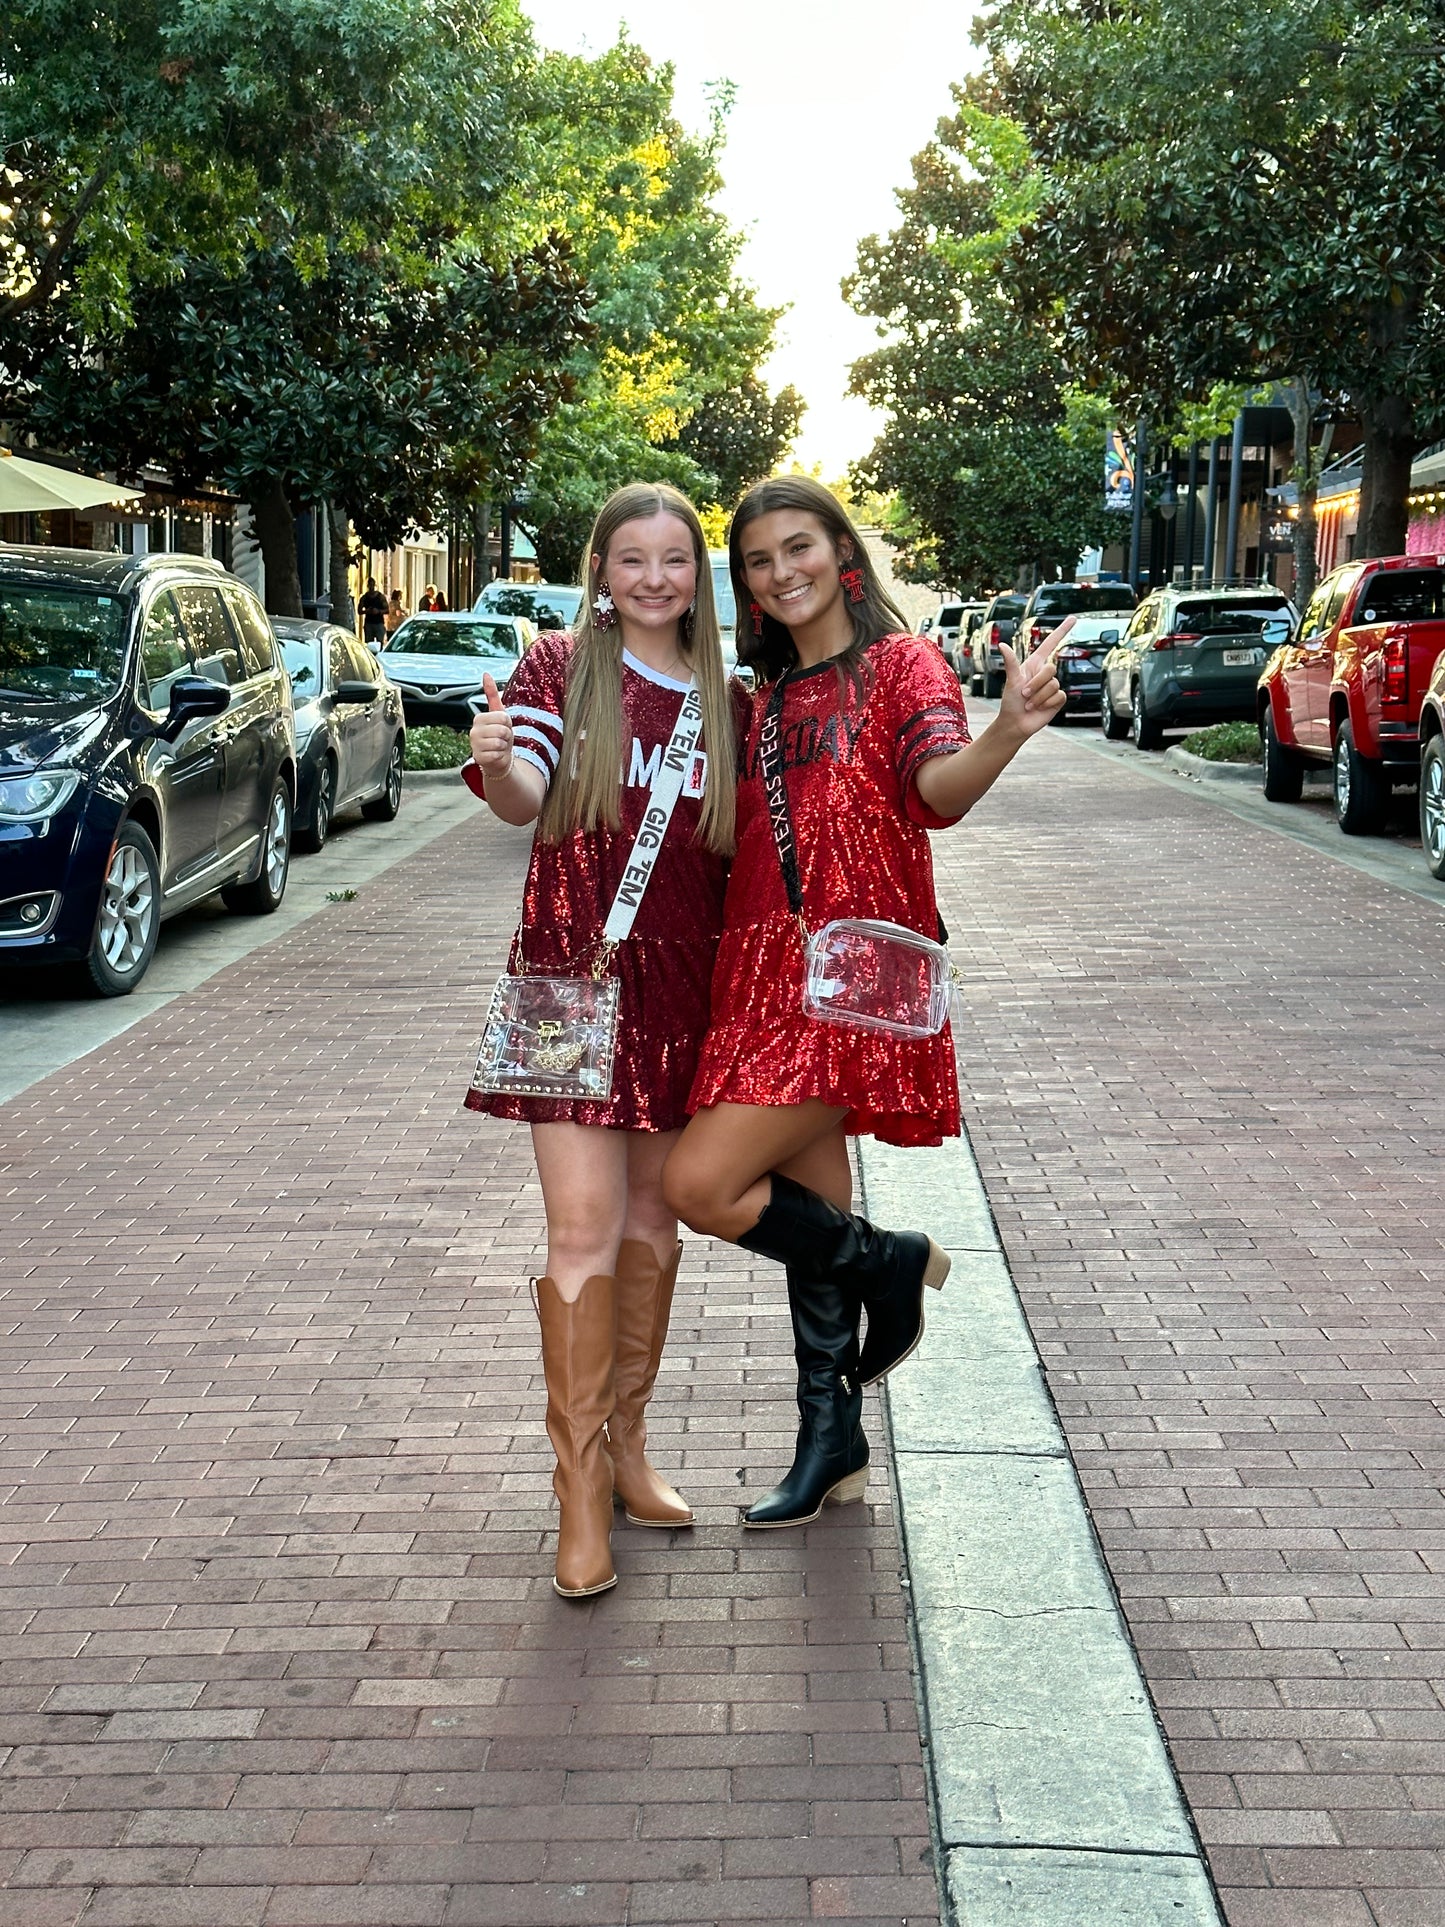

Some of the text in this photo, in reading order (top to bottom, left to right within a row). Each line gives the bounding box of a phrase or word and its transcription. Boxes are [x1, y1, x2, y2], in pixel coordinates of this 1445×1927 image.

[682, 689, 702, 721] GIG
[617, 807, 667, 908] GIG 'EM
